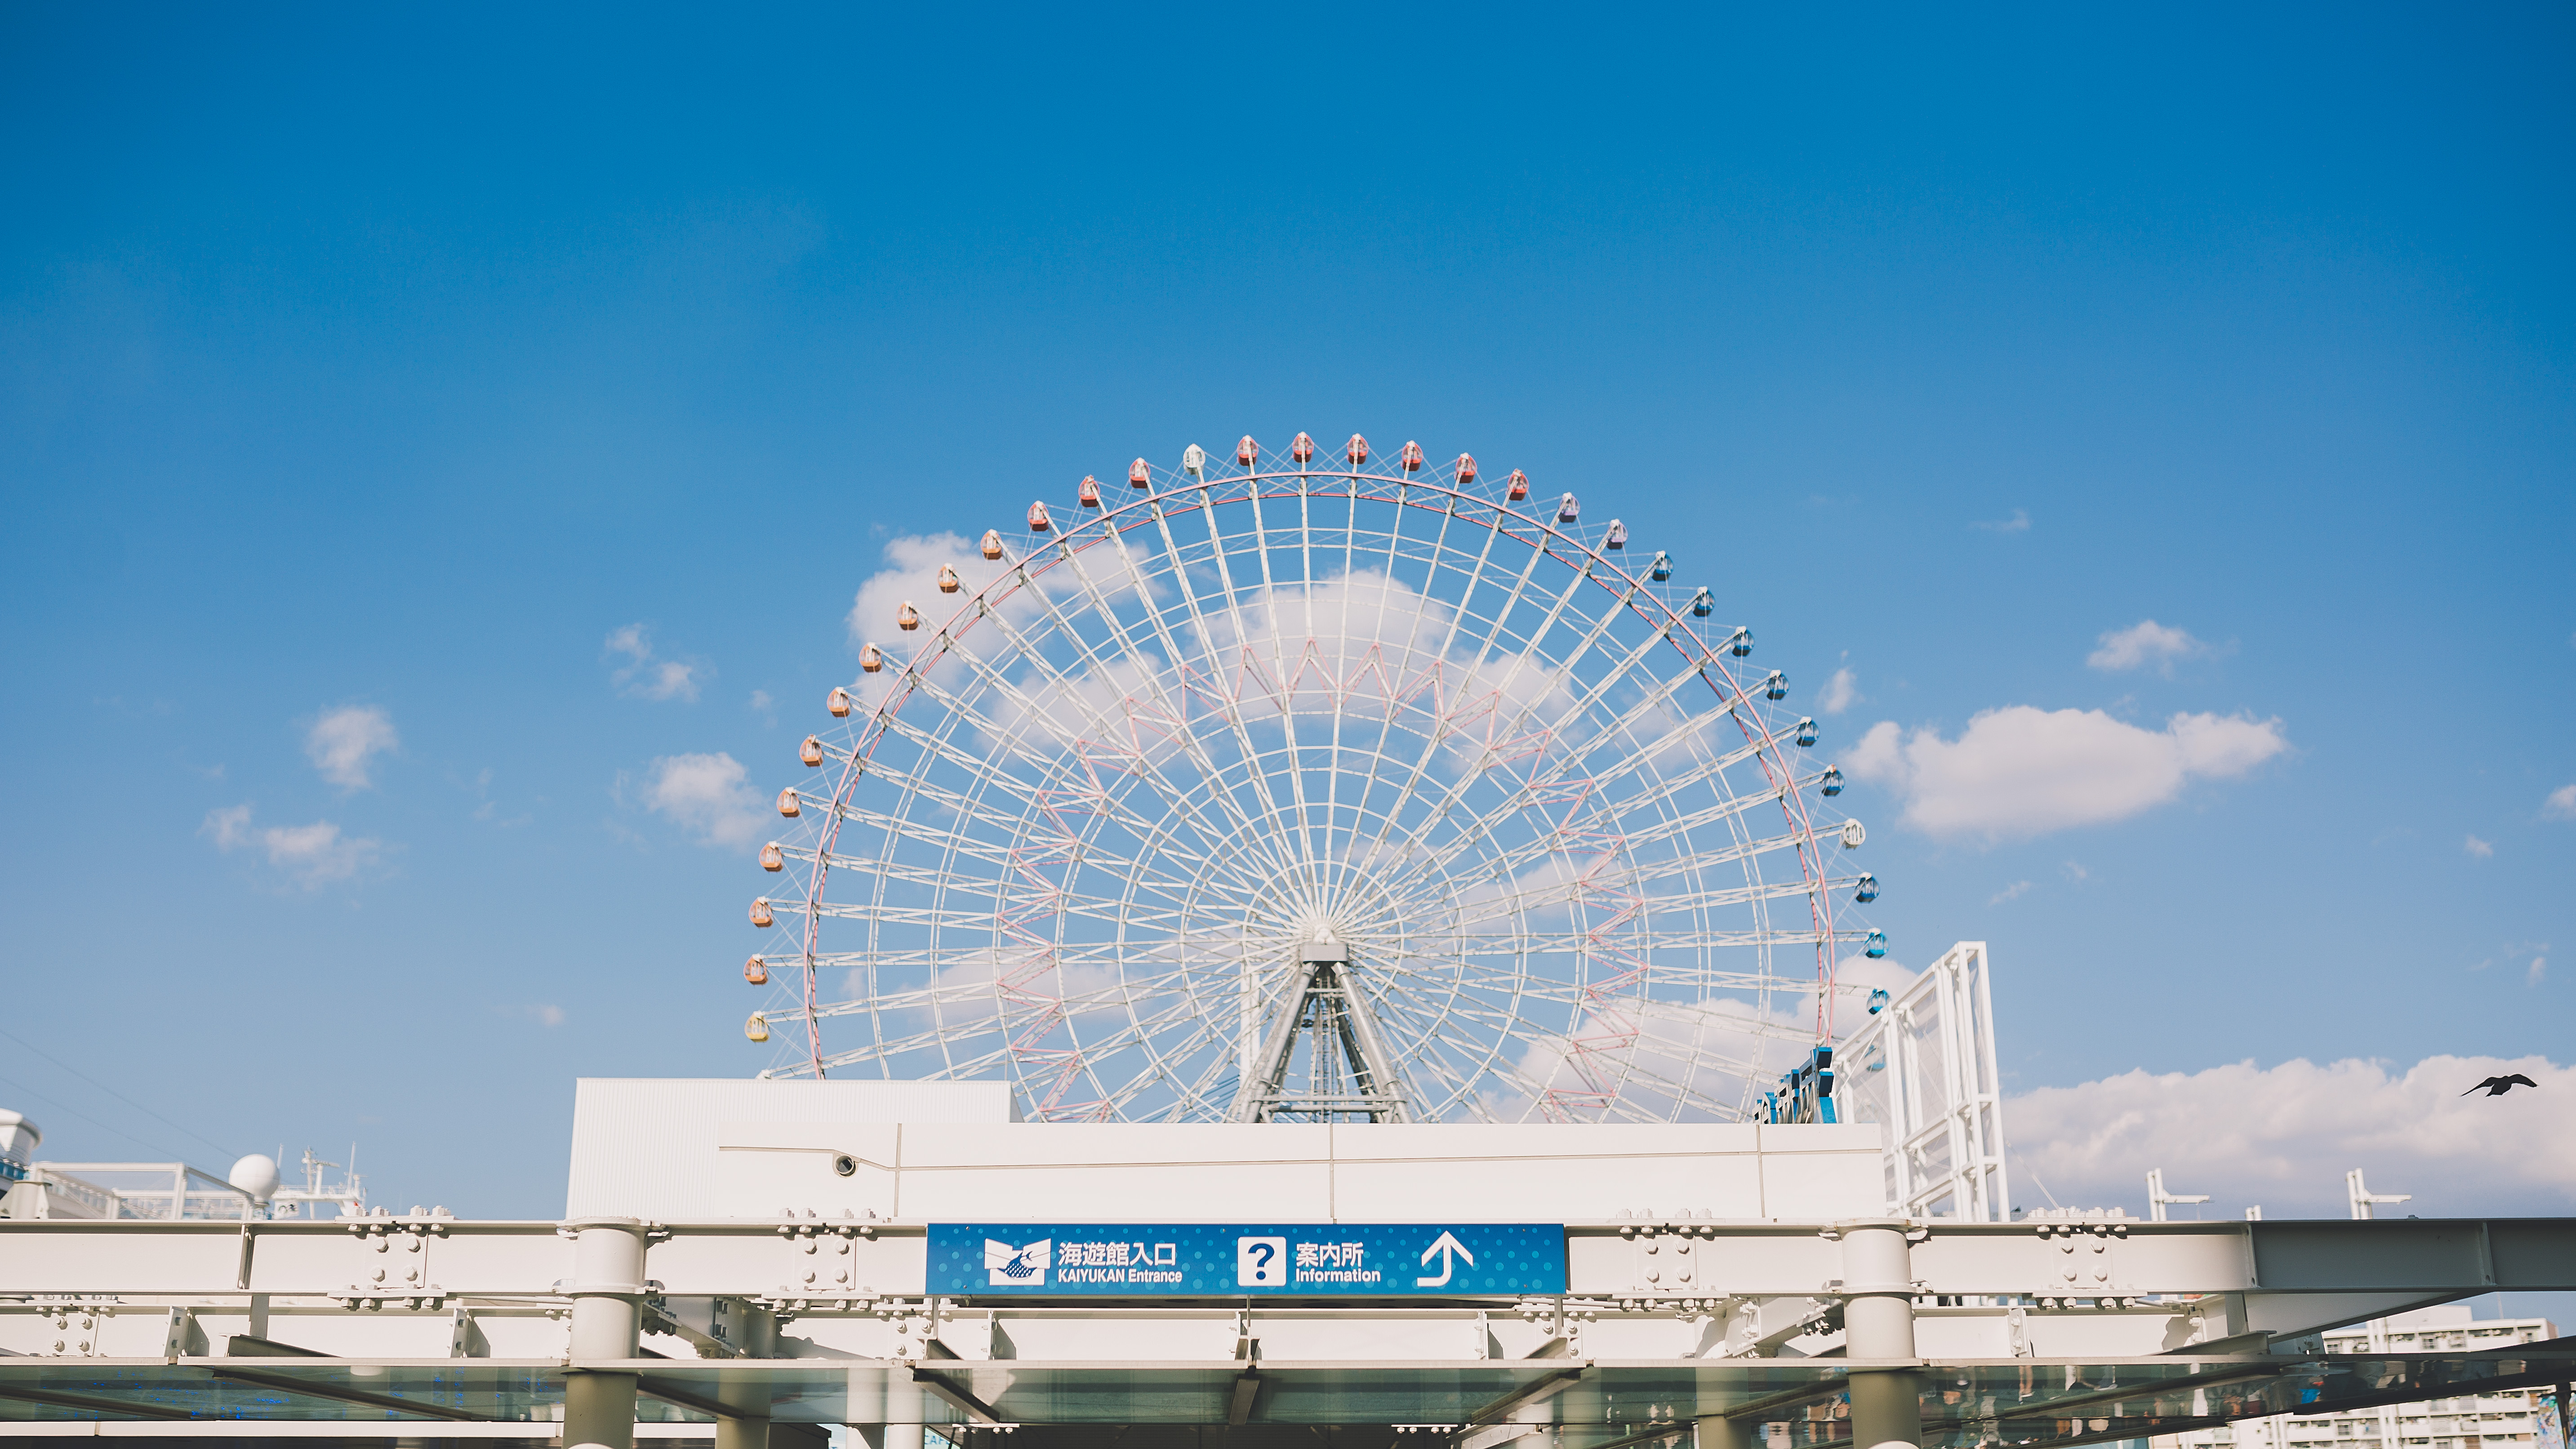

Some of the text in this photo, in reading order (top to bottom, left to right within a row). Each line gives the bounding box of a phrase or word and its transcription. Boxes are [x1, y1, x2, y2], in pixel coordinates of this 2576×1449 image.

[1058, 1242, 1176, 1267] 海遊館入口
[1296, 1242, 1364, 1267] 案内所
[1058, 1268, 1183, 1283] KAIYUKAN Entrance
[1296, 1268, 1381, 1282] Information
